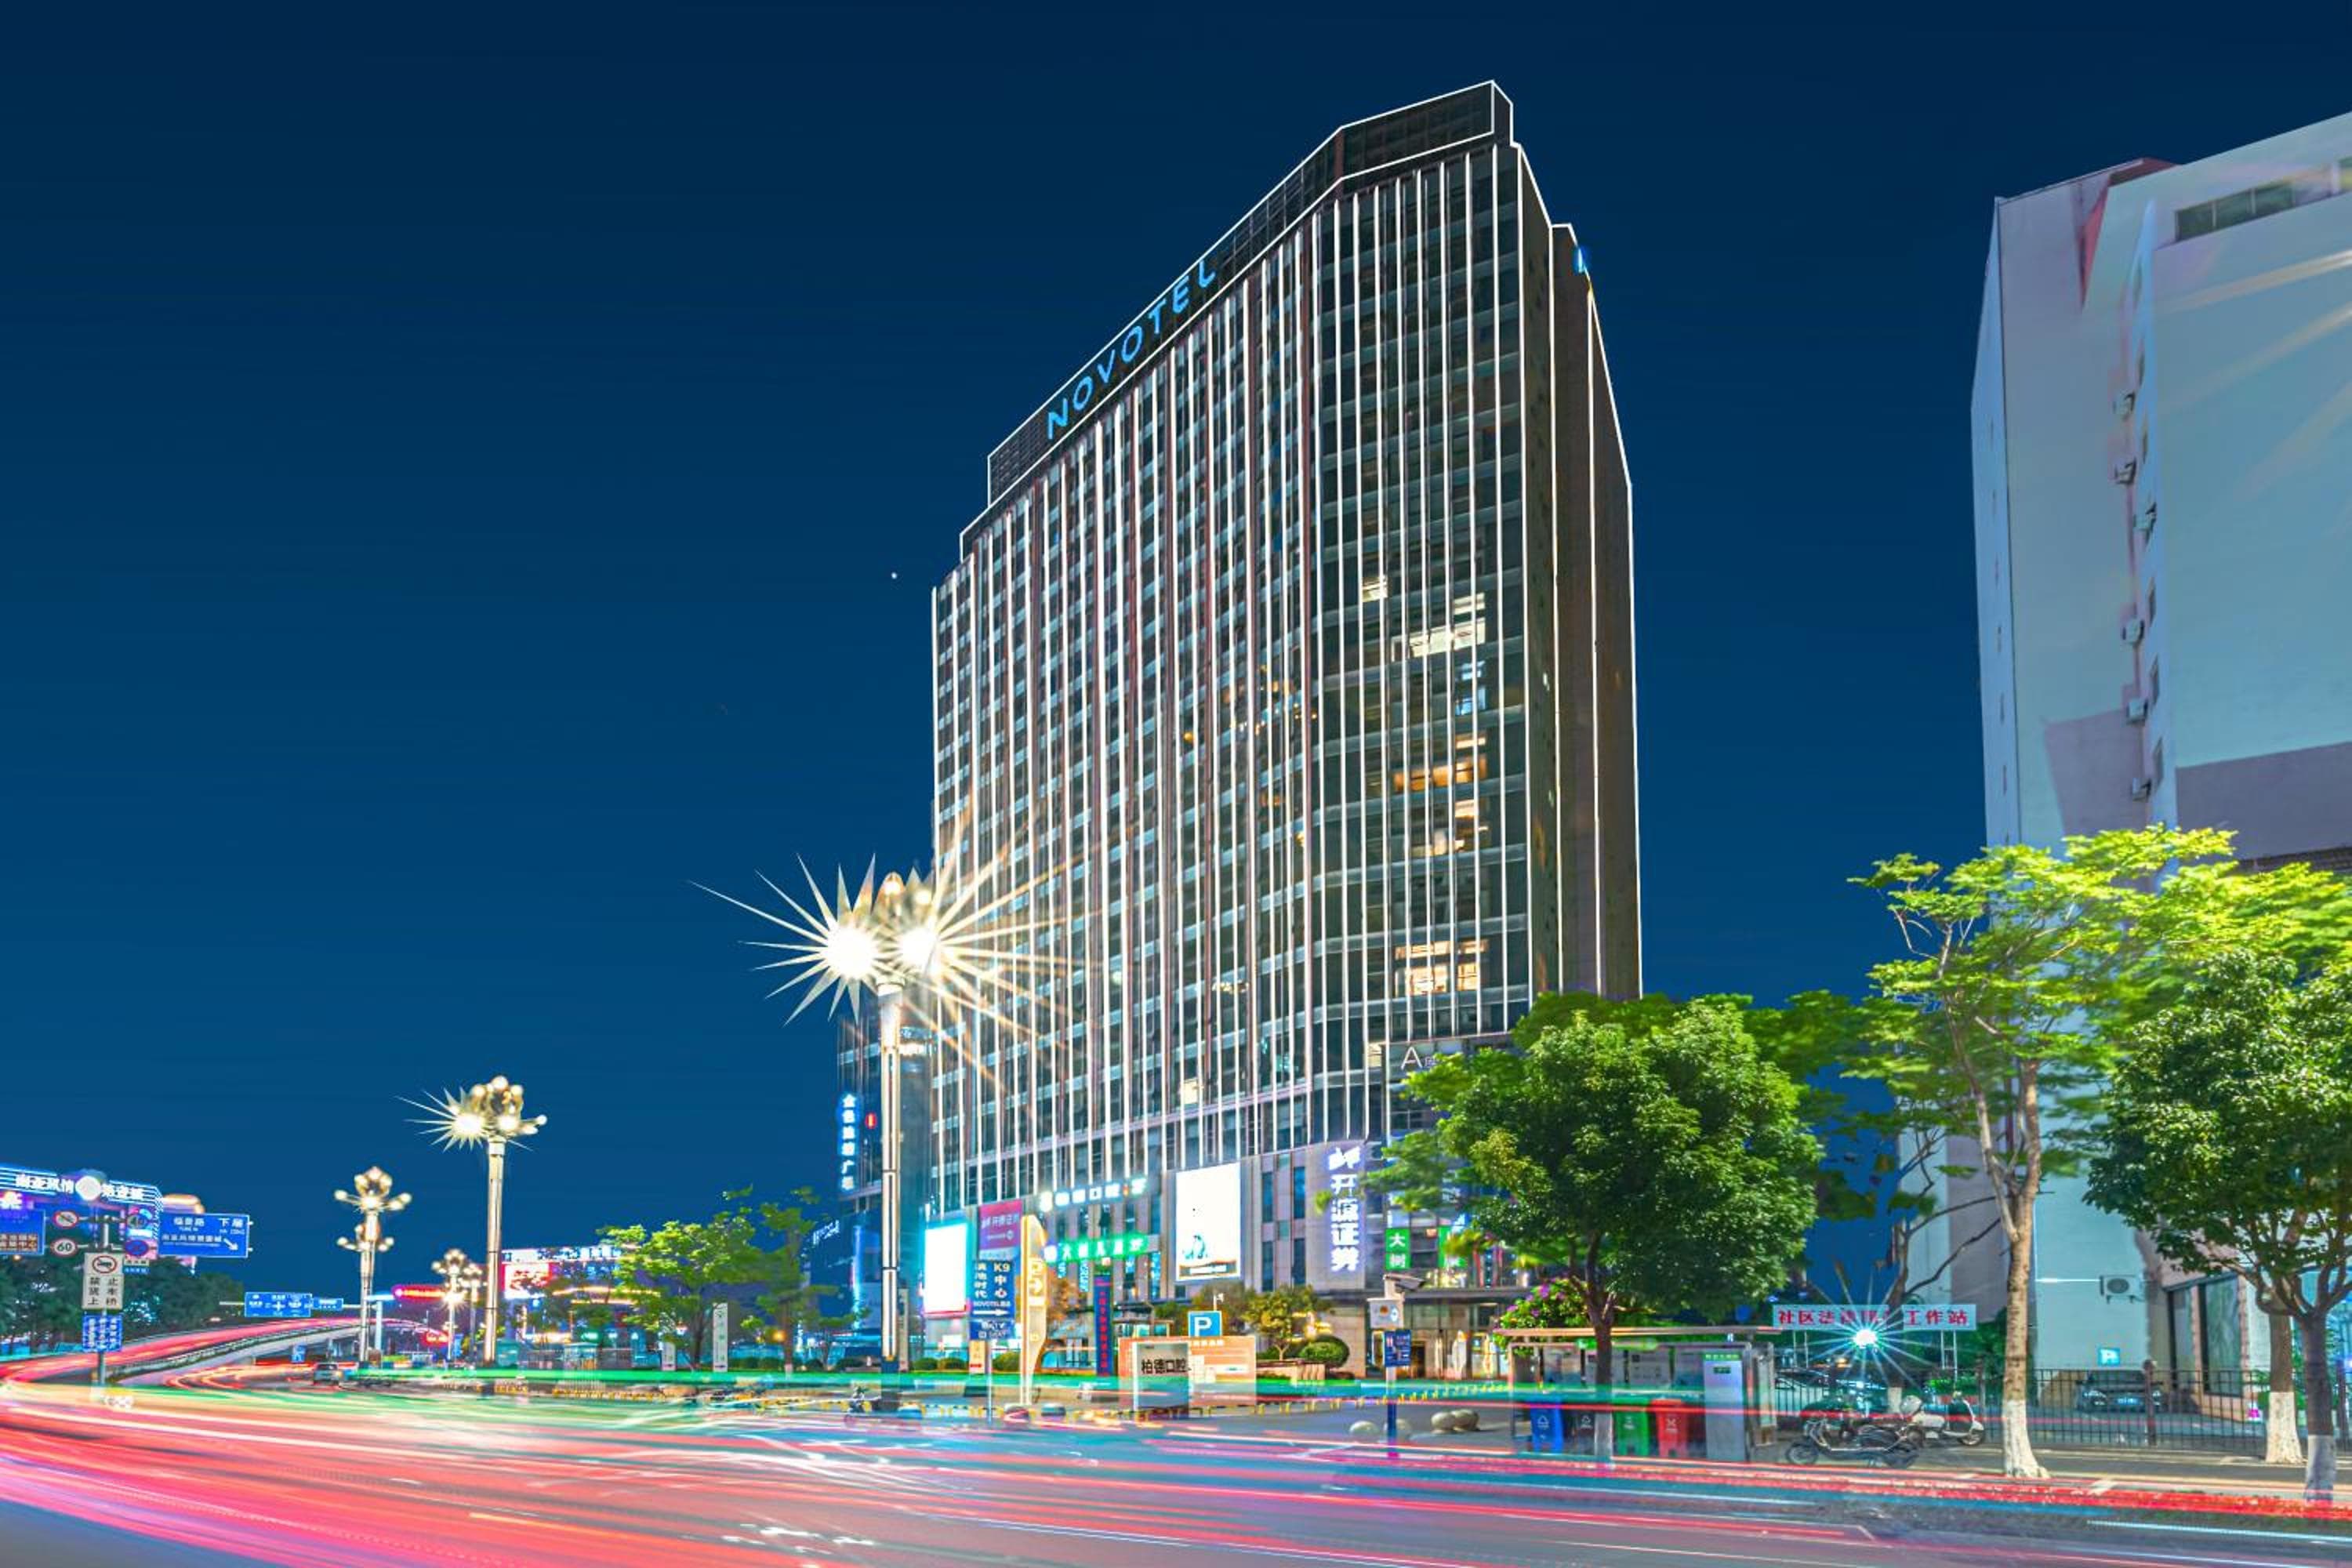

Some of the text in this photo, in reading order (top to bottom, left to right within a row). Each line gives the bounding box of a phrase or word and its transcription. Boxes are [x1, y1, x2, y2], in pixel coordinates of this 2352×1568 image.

[1047, 260, 1215, 439] NOVOTEL
[1330, 1173, 1361, 1272] 开源证券
[57, 1243, 72, 1252] 60
[1194, 1316, 1212, 1337] P
[1141, 1359, 1189, 1374] 柏德口腔
